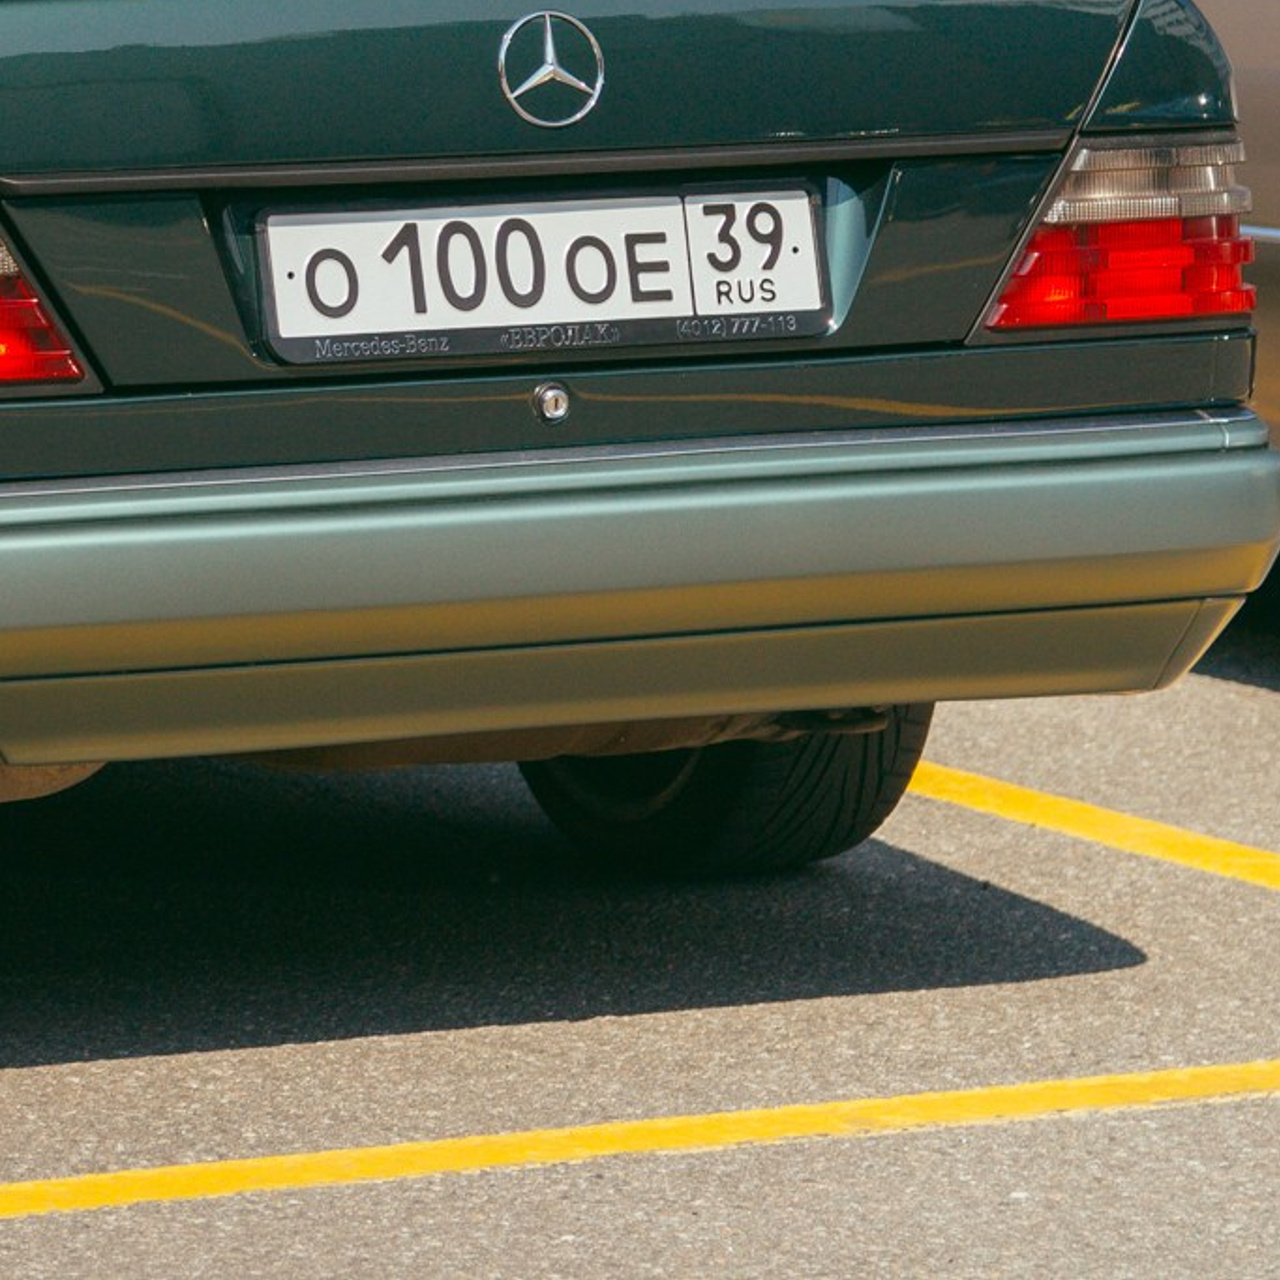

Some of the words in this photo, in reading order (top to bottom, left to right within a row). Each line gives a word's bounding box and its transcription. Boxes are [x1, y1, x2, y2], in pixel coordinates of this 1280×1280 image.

[702, 201, 785, 274] 39
[716, 278, 777, 305] RUS
[314, 333, 450, 359] Mercedes-Benz
